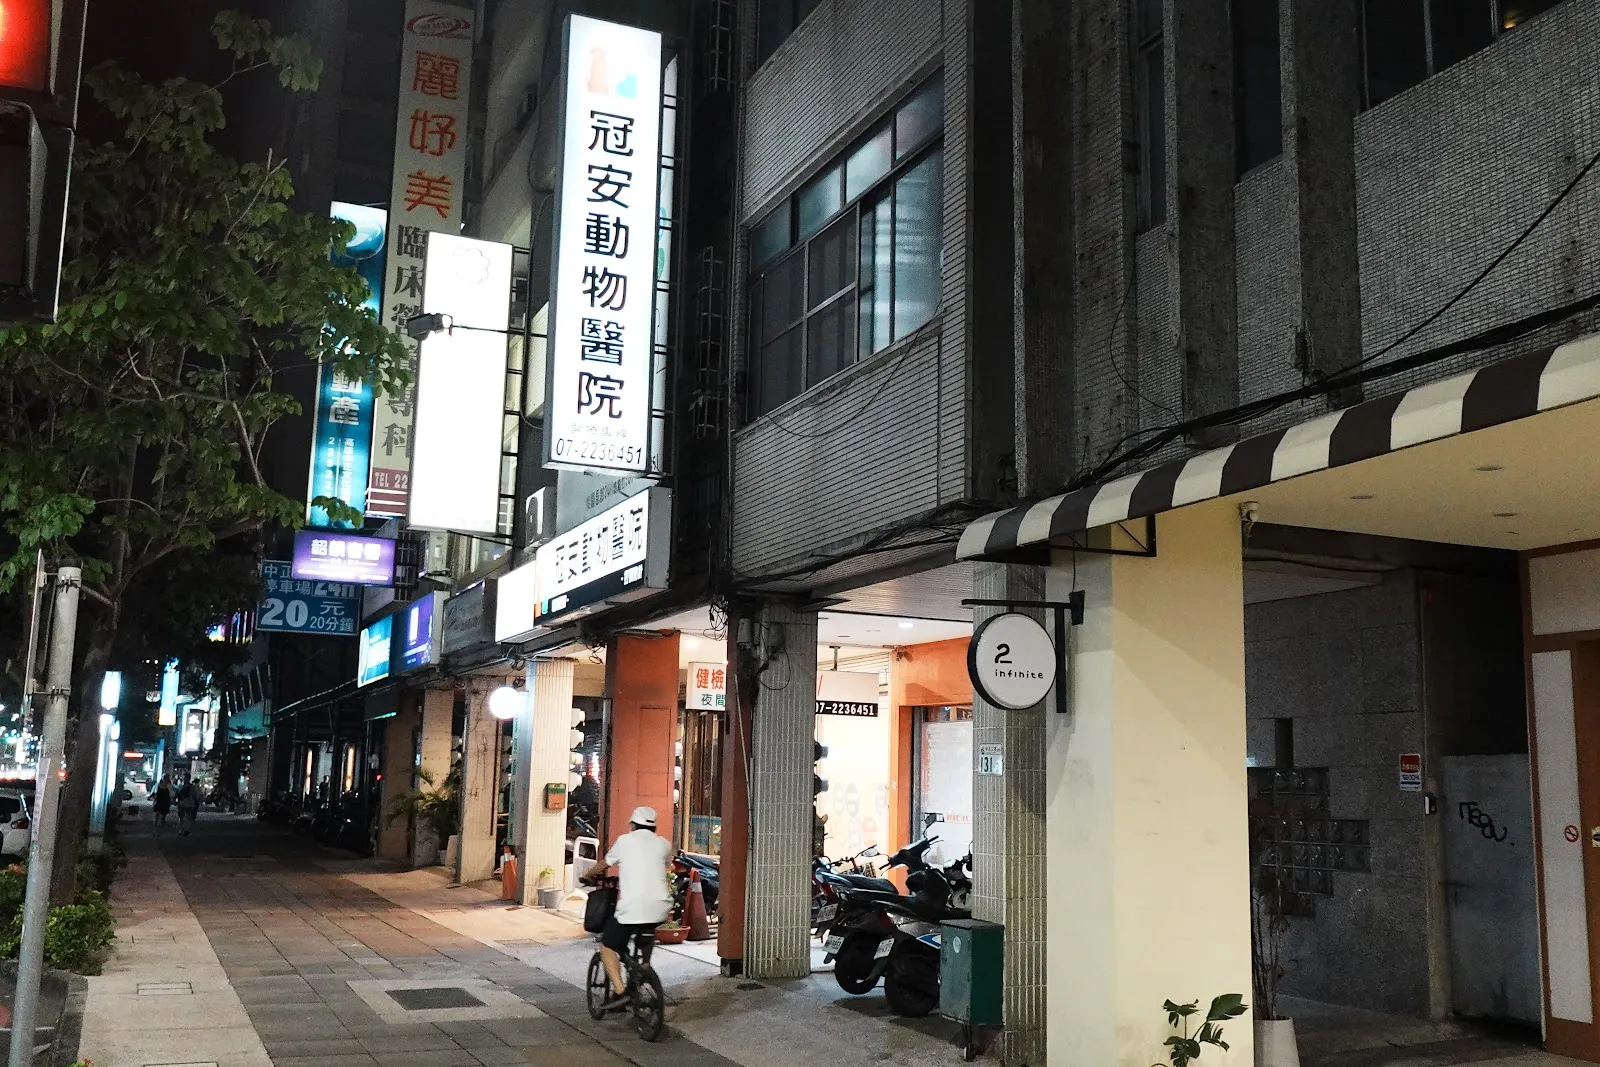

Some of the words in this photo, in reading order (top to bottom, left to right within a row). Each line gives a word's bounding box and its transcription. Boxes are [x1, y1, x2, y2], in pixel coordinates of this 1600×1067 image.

[577, 110, 635, 418] 冠安動物醫院
[556, 438, 642, 464] 07-2236451
[374, 471, 389, 488] TEL
[260, 598, 309, 628] 20
[320, 601, 345, 616] 元
[994, 643, 1012, 664] 2
[696, 668, 725, 690] 健檢
[995, 669, 1044, 679] infinite
